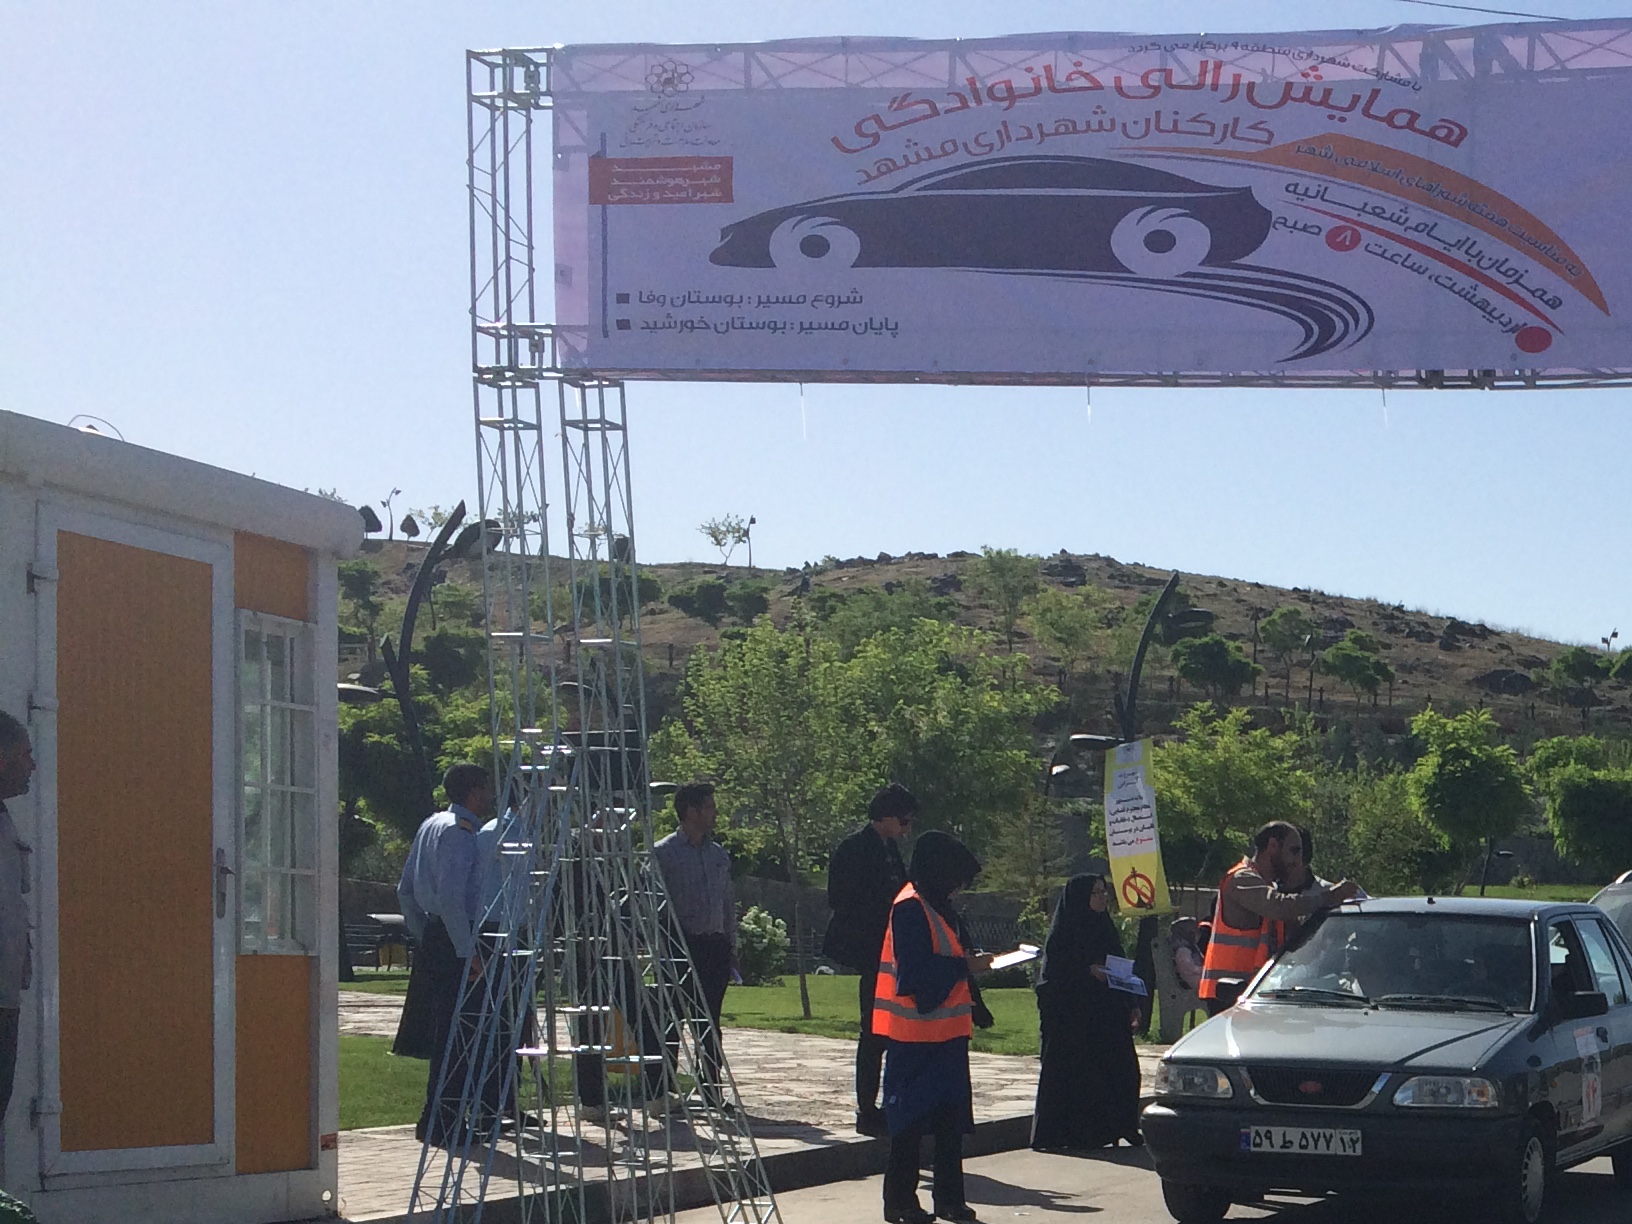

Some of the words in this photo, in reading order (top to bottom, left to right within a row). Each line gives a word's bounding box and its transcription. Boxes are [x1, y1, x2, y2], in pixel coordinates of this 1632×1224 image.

[1240, 43, 1291, 57] منطقه
[1292, 50, 1351, 68] شهرداری
[1113, 59, 1242, 103] رالی
[1351, 63, 1411, 87] مشارکت
[830, 60, 1105, 155] خانوادگی
[1245, 64, 1468, 149] همایش
[962, 104, 1116, 156] شهرداری
[1121, 110, 1275, 146] کارکنان
[856, 138, 960, 186] مشهد
[1296, 144, 1334, 162] شهر
[1285, 182, 1411, 226] شعبانیه
[1272, 216, 1322, 236] صبح
[1404, 222, 1470, 252] ایام
[1364, 243, 1429, 276] ساعت
[1464, 241, 1477, 262] با
[1476, 256, 1563, 310] همزمان
[638, 290, 667, 308] وفا
[670, 290, 744, 308] بوستان
[810, 287, 864, 308] شروع
[640, 313, 711, 335] خورشید
[714, 316, 787, 335] بوستان
[851, 316, 899, 338] پایان
[1252, 1129, 1275, 1149] ۵۹
[1279, 1130, 1294, 1149] ط
[1299, 1131, 1333, 1151] ۵۷۷
[1339, 1136, 1360, 1153] ۱۲
